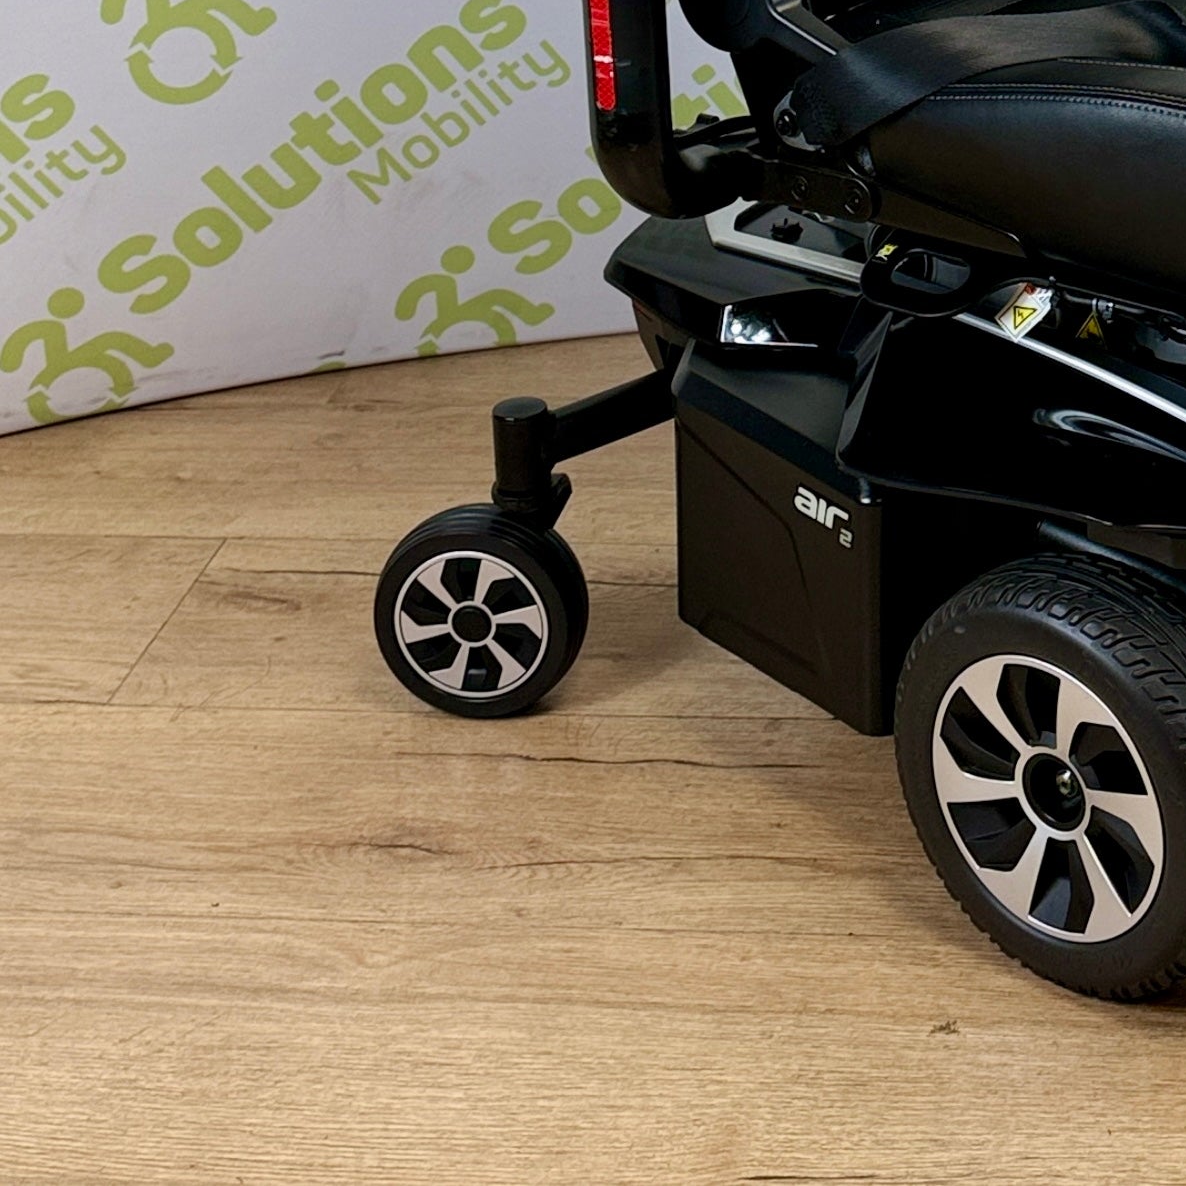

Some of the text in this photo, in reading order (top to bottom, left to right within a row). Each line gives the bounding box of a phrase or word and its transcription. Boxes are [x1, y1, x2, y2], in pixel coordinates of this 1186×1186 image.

[347, 40, 571, 204] Mobility
[794, 486, 853, 548] air 2
